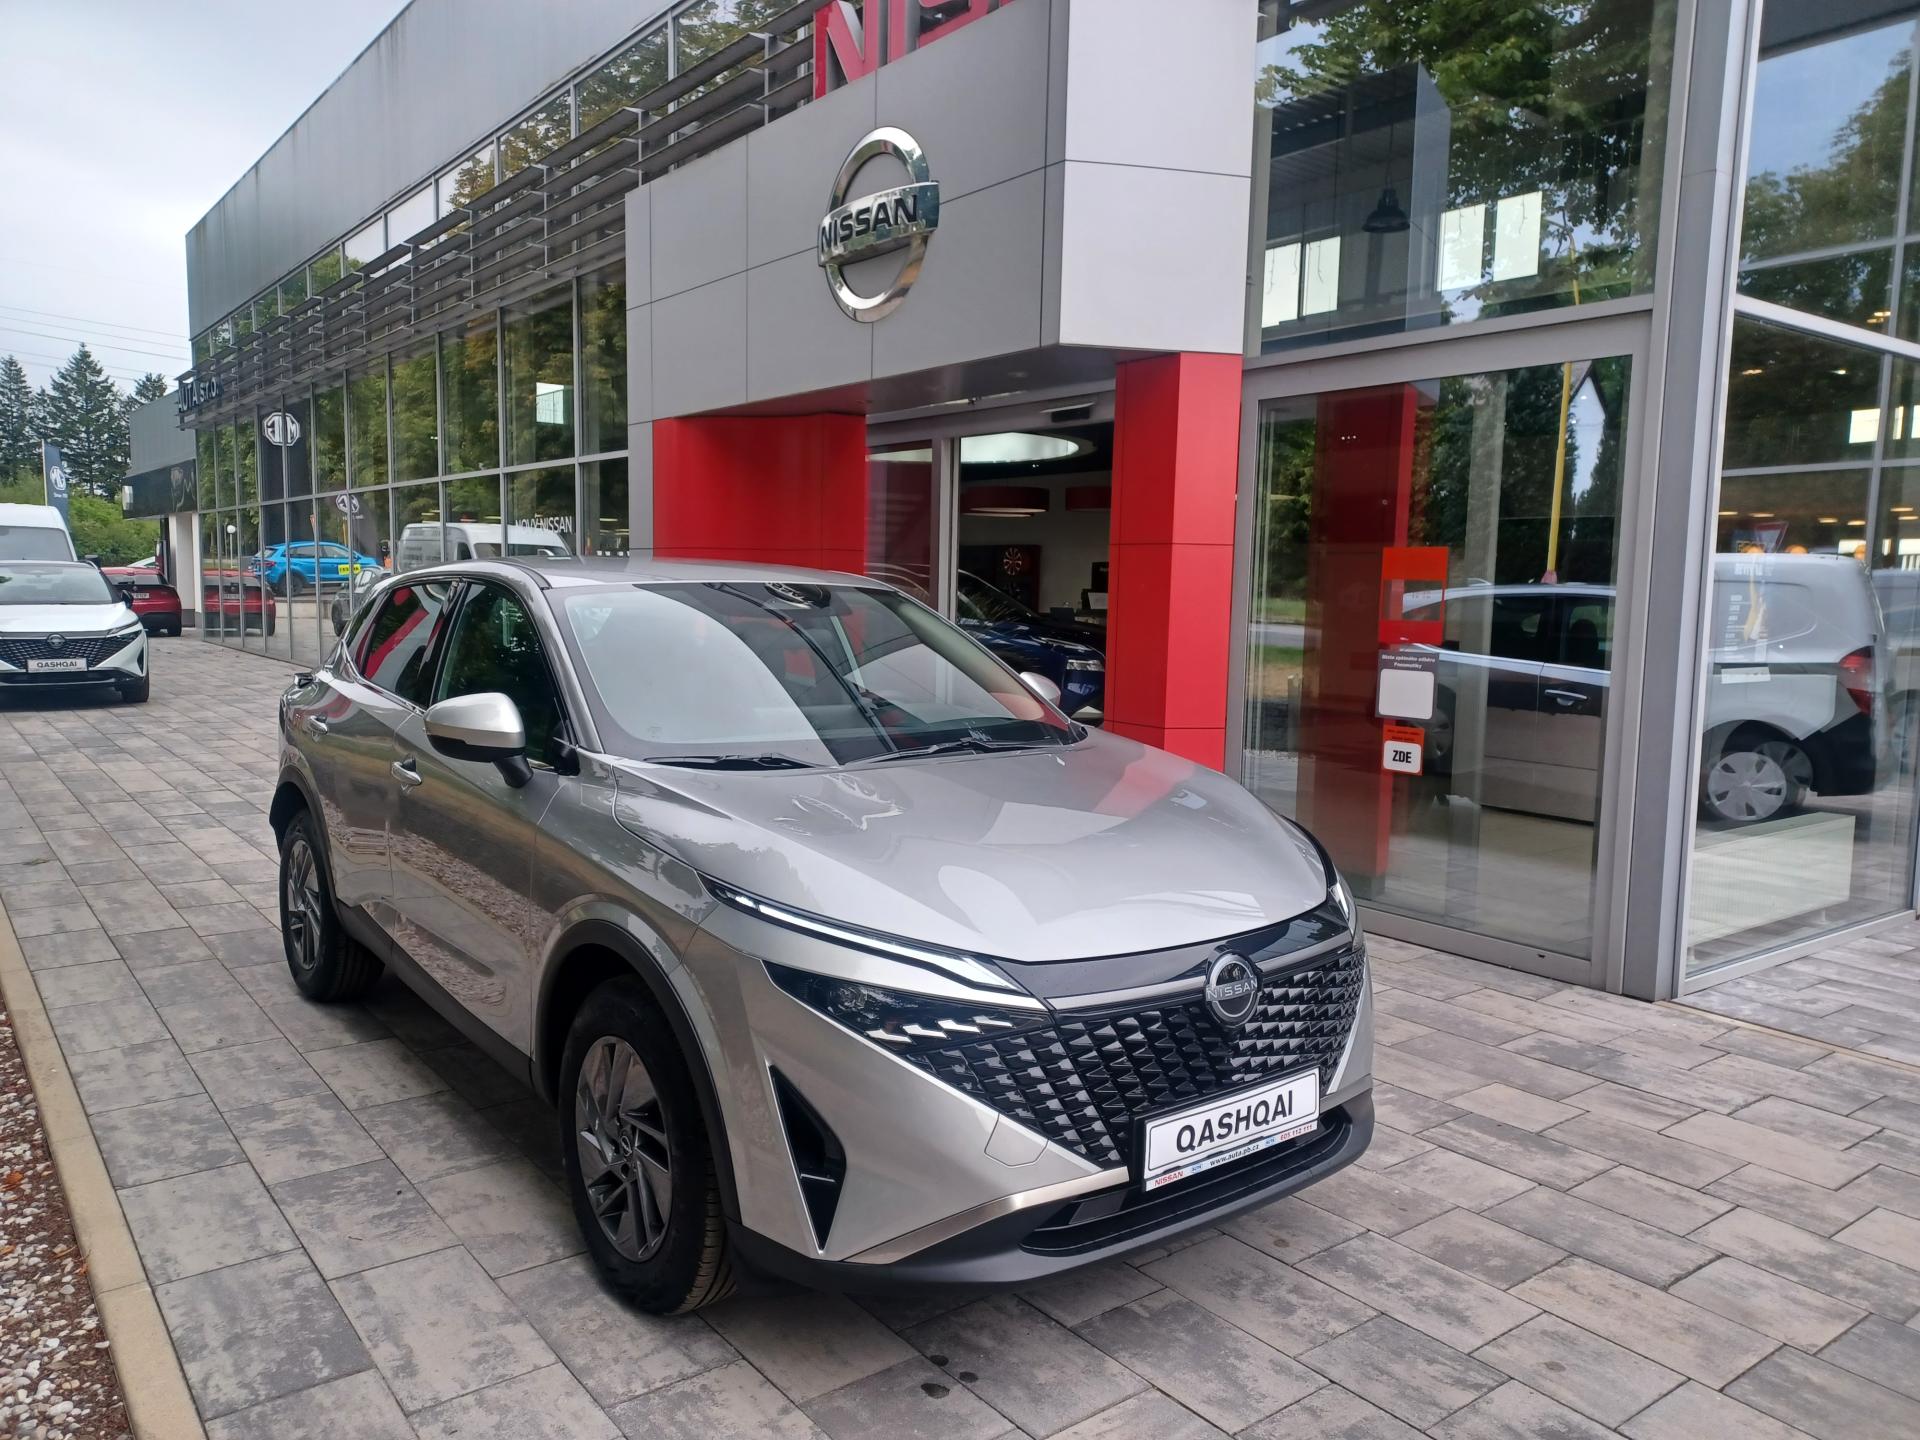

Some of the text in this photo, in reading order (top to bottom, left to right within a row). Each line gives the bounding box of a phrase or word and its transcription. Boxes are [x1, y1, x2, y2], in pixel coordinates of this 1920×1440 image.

[821, 194, 917, 254] NISSAN
[540, 516, 572, 534] NISSAN
[1392, 750, 1412, 764] ZDE
[1207, 978, 1257, 999] NISSAN
[1176, 1090, 1293, 1153] QASHQAI
[1154, 1171, 1184, 1186] NISSAN
